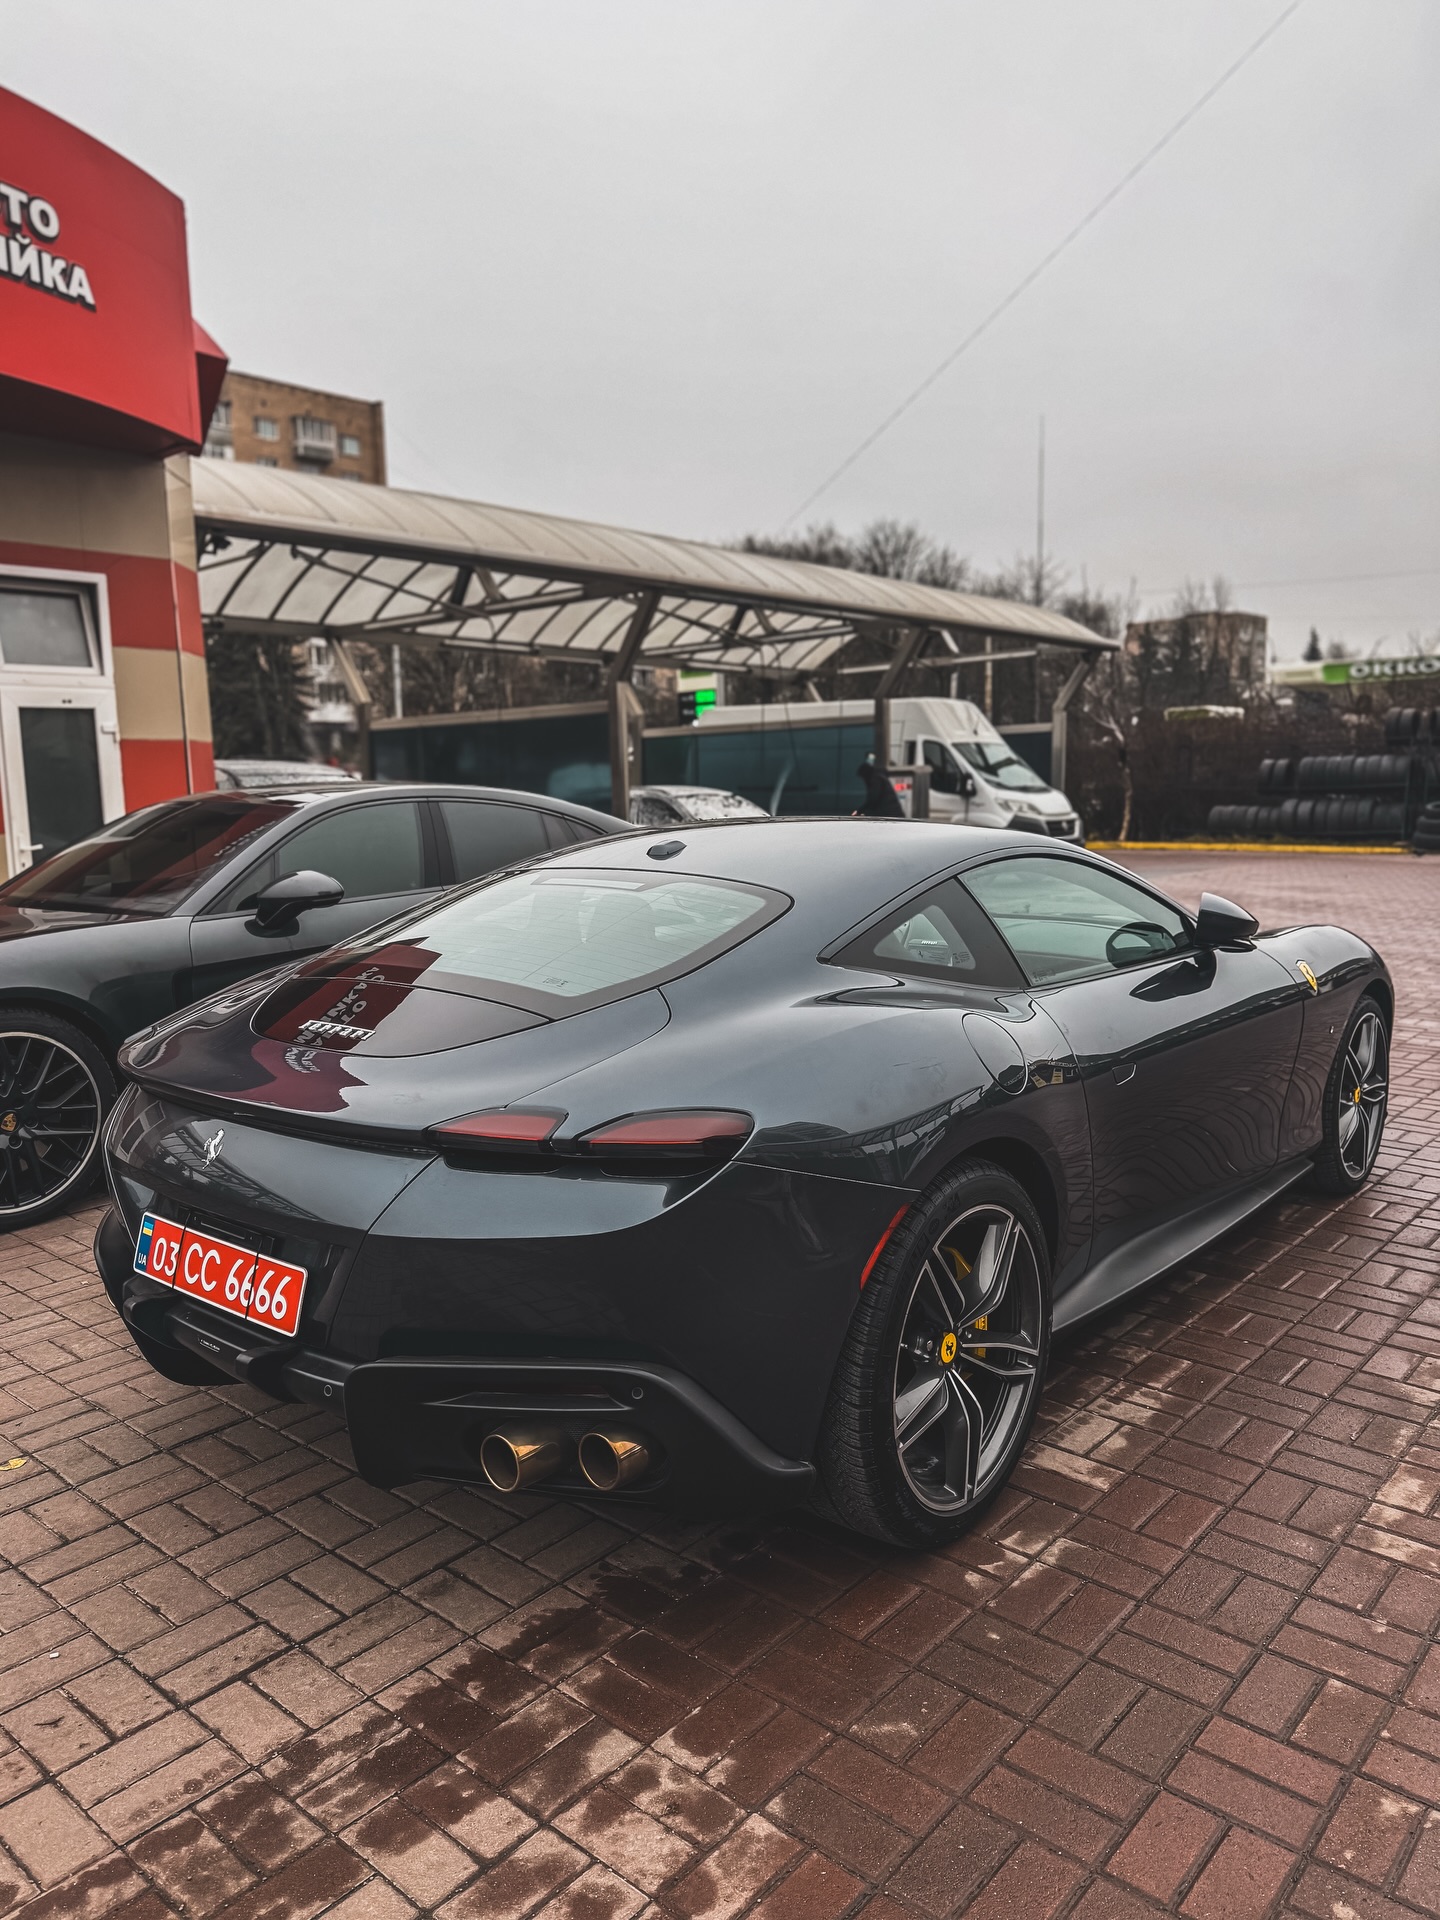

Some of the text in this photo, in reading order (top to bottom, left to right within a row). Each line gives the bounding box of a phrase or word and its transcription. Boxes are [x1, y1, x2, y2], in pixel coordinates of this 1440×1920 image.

[0, 232, 96, 306] ЙКА
[298, 1020, 376, 1041] Ferrari
[137, 1252, 147, 1266] UA
[152, 1237, 292, 1320] 03 CC 6666
